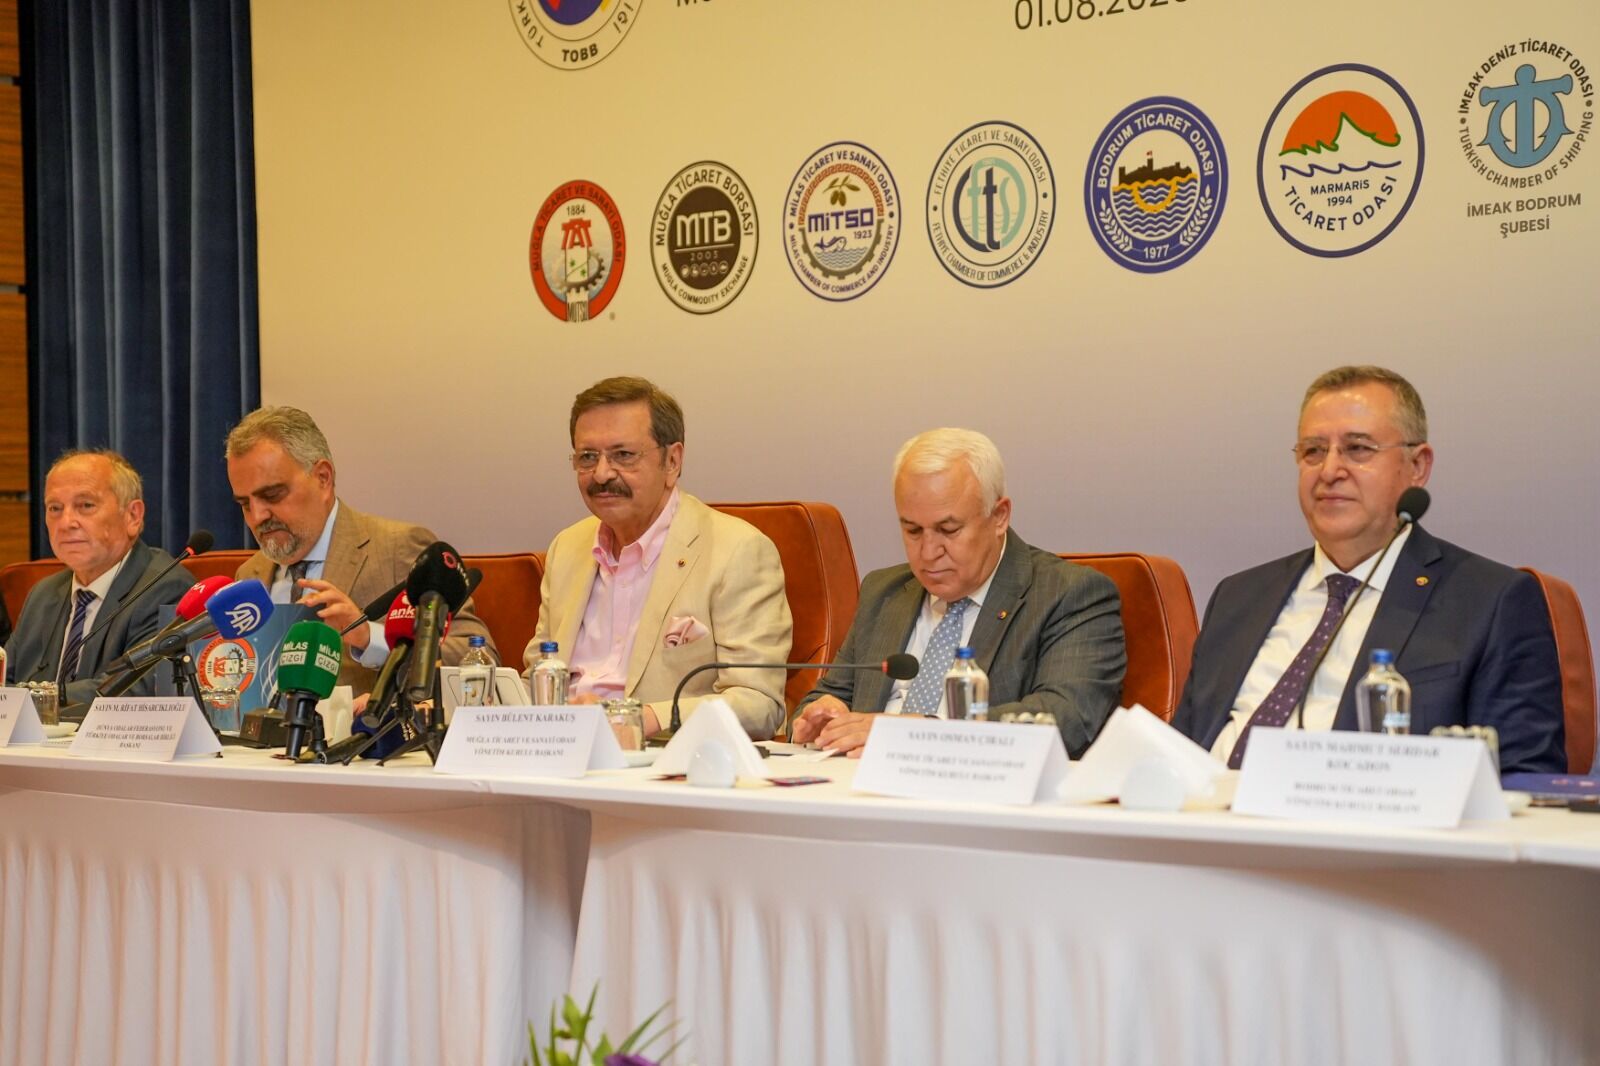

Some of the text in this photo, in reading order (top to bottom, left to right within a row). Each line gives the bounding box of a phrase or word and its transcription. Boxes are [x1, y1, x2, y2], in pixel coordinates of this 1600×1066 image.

[562, 43, 599, 63] TOBB
[1457, 37, 1594, 114] İMEAK DENİZ TİCARET ODASI
[1097, 112, 1215, 189] BODRUM TİCARET ODASI
[1459, 111, 1594, 189] TURKISH CHAMBER OF SHIPPING
[836, 150, 848, 161] VE
[877, 173, 894, 207] ODASI
[566, 204, 586, 217] 1884
[655, 193, 678, 246] MUĞLA
[722, 176, 754, 236] BORSASI
[1327, 195, 1353, 207] 1994
[1352, 175, 1397, 226] ODASI
[1467, 192, 1582, 218] İMEAK BODRUM
[676, 209, 732, 247] MTB
[853, 229, 873, 240] 1923
[1500, 215, 1551, 239] ŞUBESİ
[1143, 244, 1170, 260] 1977
[720, 256, 749, 298] EXCHANGE
